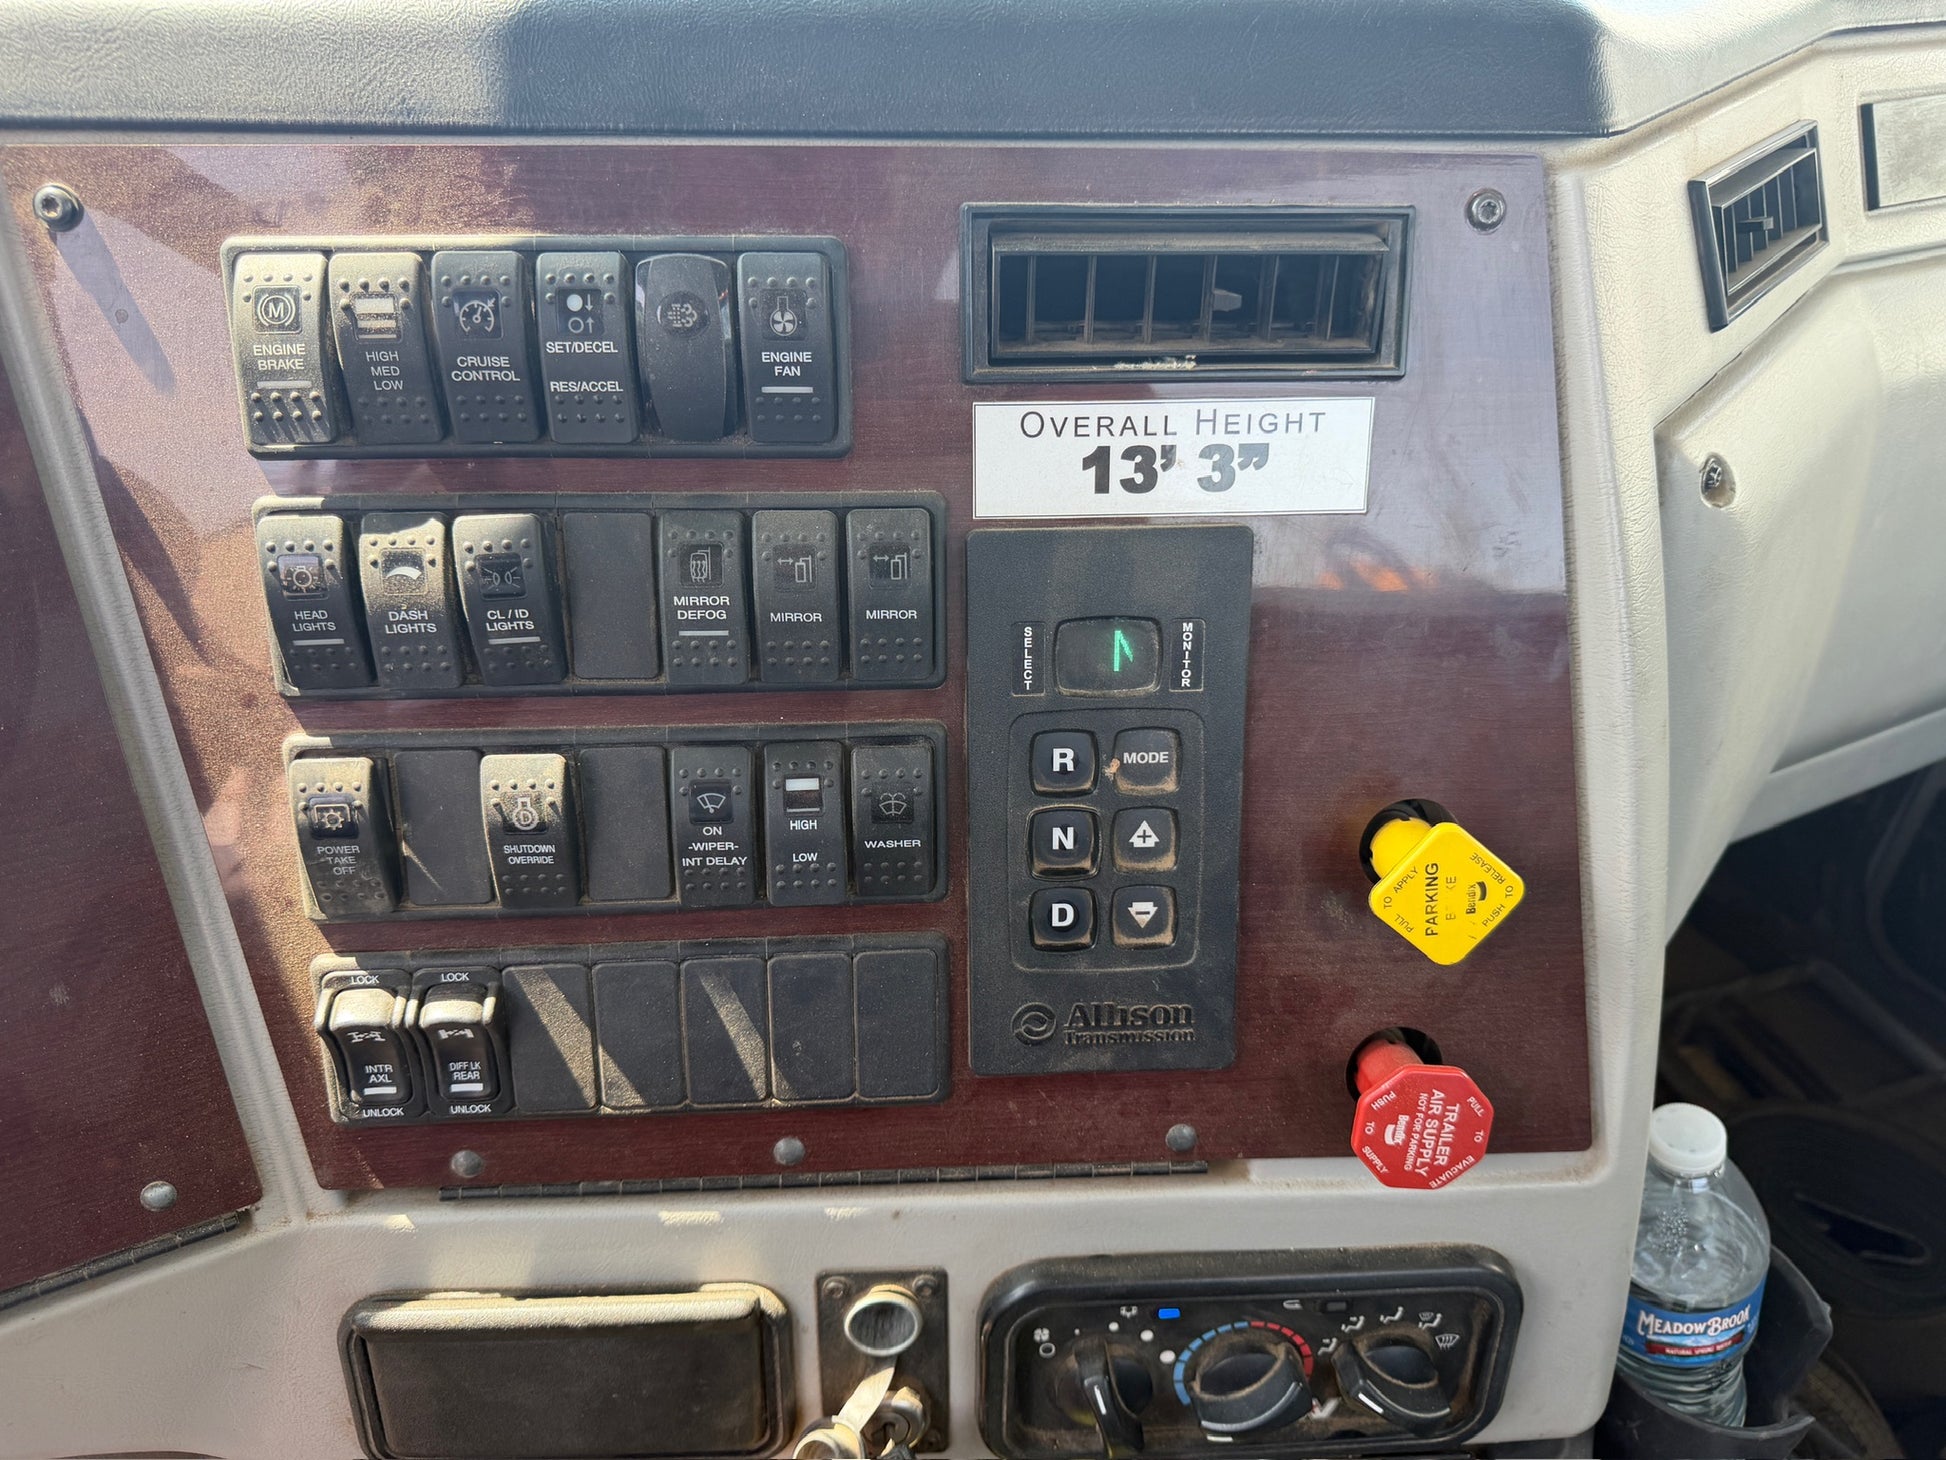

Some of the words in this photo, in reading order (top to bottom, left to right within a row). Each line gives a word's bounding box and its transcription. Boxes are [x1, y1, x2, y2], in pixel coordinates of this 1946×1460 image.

[253, 344, 306, 356] ENGINE
[546, 341, 618, 353] SET/DECEL
[366, 351, 399, 362] HIGH
[456, 356, 510, 367] CRUISE
[761, 351, 812, 363] ENGINE
[258, 359, 304, 370] BRAKE
[371, 366, 400, 377] MED
[451, 370, 520, 382] CONTROL
[774, 365, 801, 377] FAN
[373, 380, 404, 391] LOW
[550, 381, 623, 392] RES/ACCEL
[1020, 410, 1178, 438] OVERALL
[1195, 409, 1326, 435] HEIGHT
[673, 596, 730, 606] MIRROR
[294, 609, 328, 620] HEAD
[388, 610, 428, 621] DASH
[677, 610, 727, 620] DEFOG
[770, 612, 822, 623] MIRROR
[865, 609, 918, 620] MIRROR
[292, 621, 336, 632] LIGHTS
[384, 623, 437, 634] LIGHTS
[486, 621, 535, 631] LIGHTS
[1023, 626, 1033, 691] SELECT
[1181, 622, 1193, 688] MONITOR
[1052, 747, 1075, 772] R
[1123, 751, 1169, 765] MODE
[789, 820, 817, 830] HIGH
[702, 826, 722, 836] ON
[864, 839, 921, 849] WASHER
[1052, 827, 1074, 850] N
[316, 845, 360, 855] POWER
[503, 844, 556, 854] SHUTDOWN
[327, 855, 357, 865] TAKE
[508, 855, 555, 865] OVERRIDE
[682, 857, 702, 867] INT
[706, 856, 748, 866] DELAY
[792, 853, 818, 863] LOW
[333, 866, 356, 876] OFF
[1469, 852, 1506, 885] RELEASE
[1393, 866, 1419, 894] APPLY
[1505, 885, 1513, 899] TO
[1383, 896, 1392, 909] TO
[1425, 862, 1439, 936] PARKING
[1051, 903, 1075, 927] D
[1481, 903, 1506, 927] PUSH
[1394, 913, 1414, 933] PULL
[350, 975, 380, 985] LOCK
[441, 972, 470, 982] LOCK
[1063, 1001, 1197, 1028] Allison
[1063, 1027, 1197, 1045] Transmission
[365, 1064, 393, 1074] INTR
[449, 1062, 468, 1071] DIFF
[469, 1061, 481, 1070] LK
[369, 1073, 392, 1083] AXL
[453, 1071, 481, 1081] REAR
[1371, 1090, 1397, 1111] PUSH
[1417, 1092, 1428, 1111] NOT
[1428, 1089, 1446, 1115] AIR
[362, 1106, 404, 1117] UNLOCK
[450, 1104, 492, 1114] UNLOCK
[1466, 1096, 1486, 1117] PULL
[1365, 1121, 1375, 1135] TO
[1413, 1113, 1424, 1132] FOR
[1433, 1103, 1460, 1166] TRAILER
[1473, 1129, 1484, 1143] TO
[1404, 1133, 1420, 1171] PARKING
[1415, 1119, 1440, 1177] SUPPLY
[1361, 1145, 1389, 1174] SUPPLY
[1429, 1155, 1475, 1188] EVACUATE
